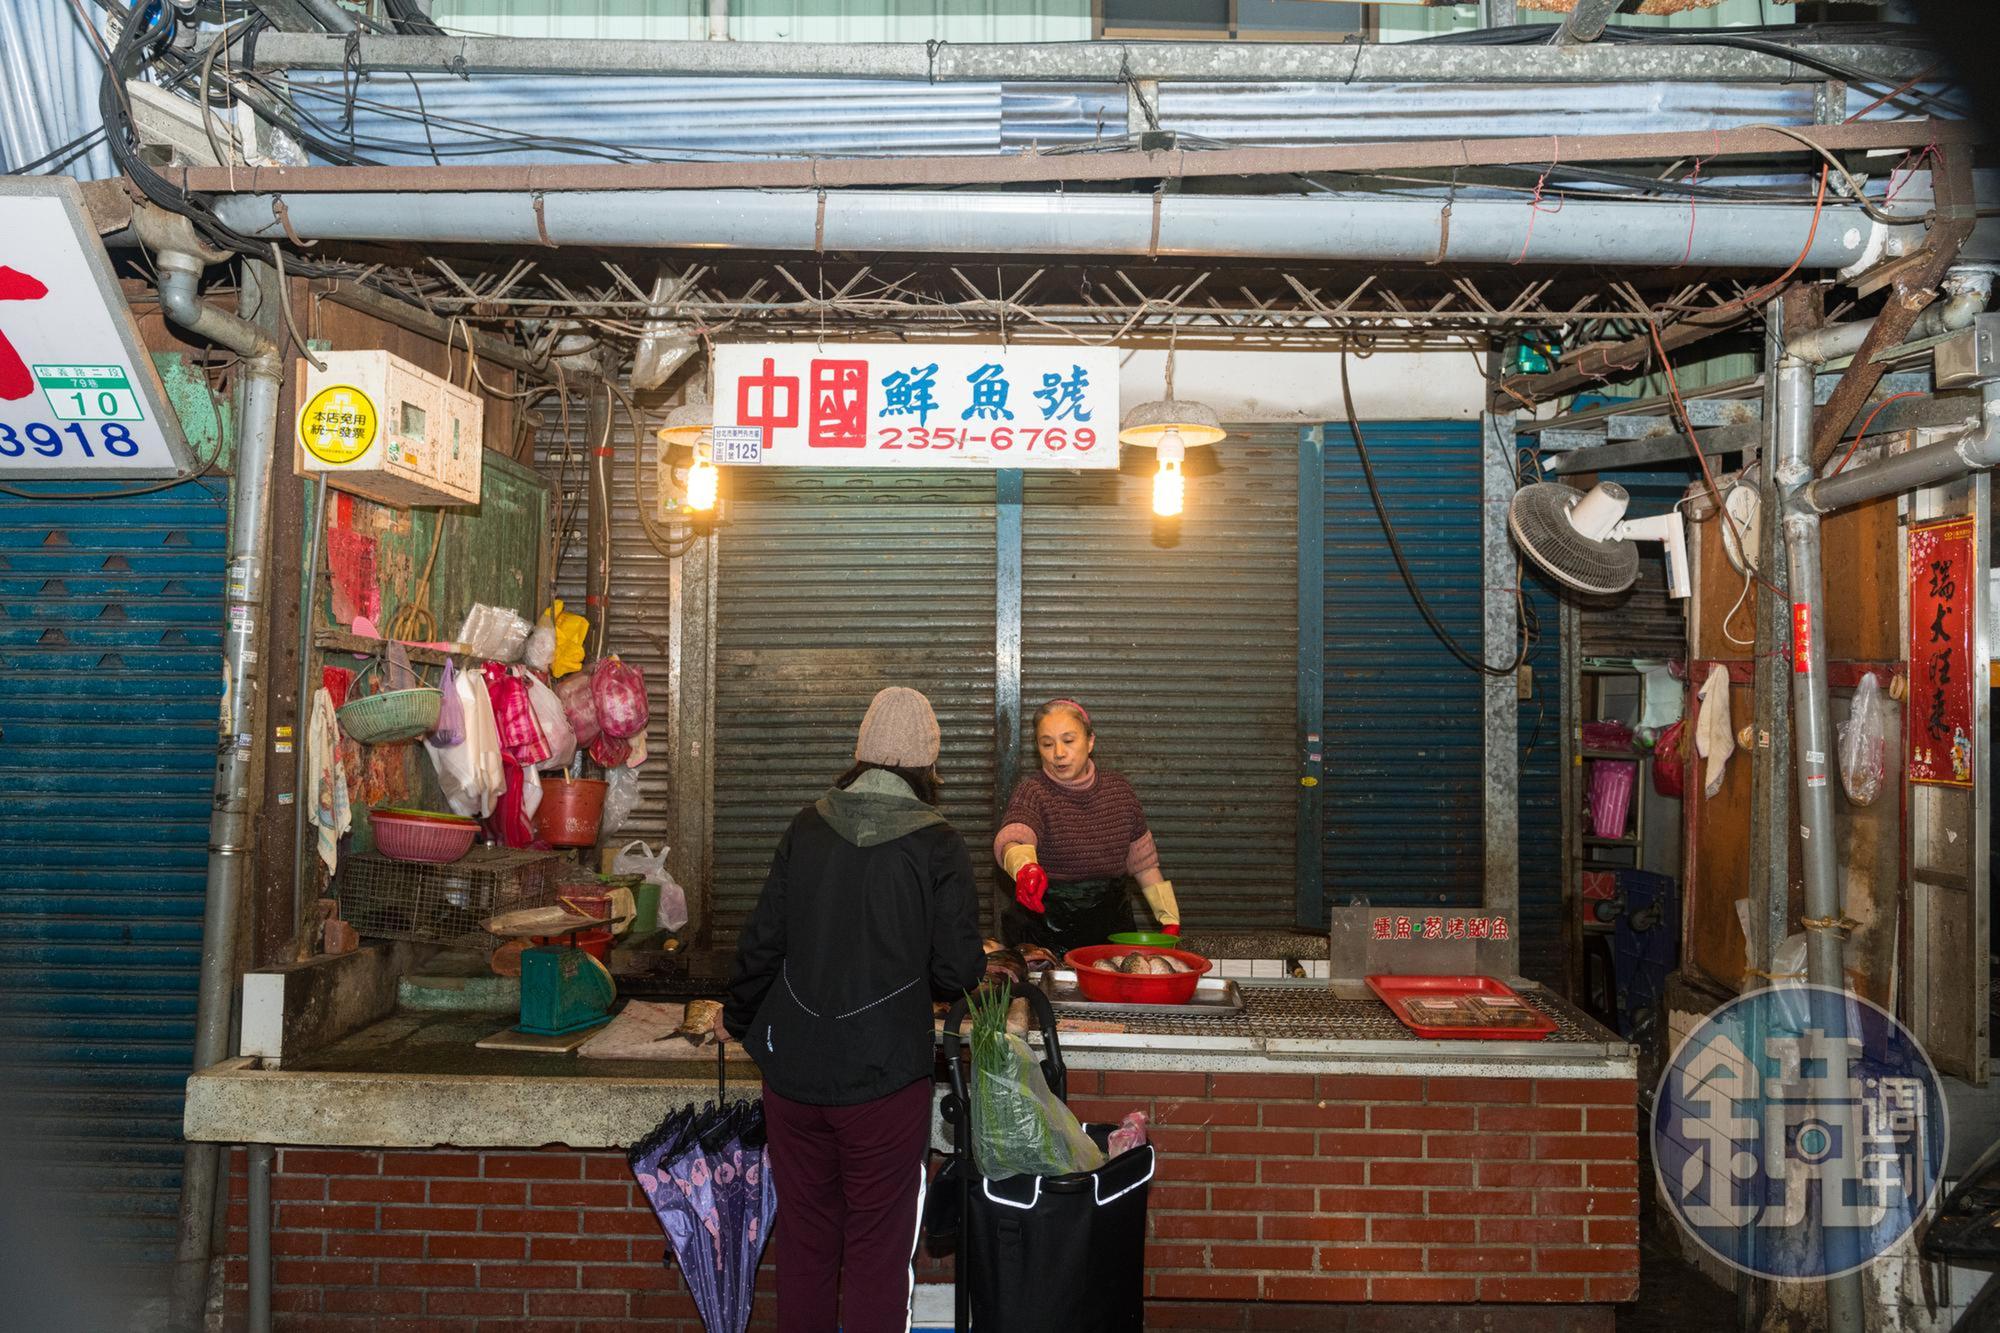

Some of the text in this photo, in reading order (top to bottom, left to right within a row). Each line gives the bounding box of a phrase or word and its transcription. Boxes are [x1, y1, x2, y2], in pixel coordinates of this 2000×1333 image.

[70, 391, 118, 416] 10
[312, 411, 367, 426] 本店免用
[310, 423, 367, 439] 統一發票
[877, 426, 1096, 452] 2351-6769
[735, 442, 758, 460] 125
